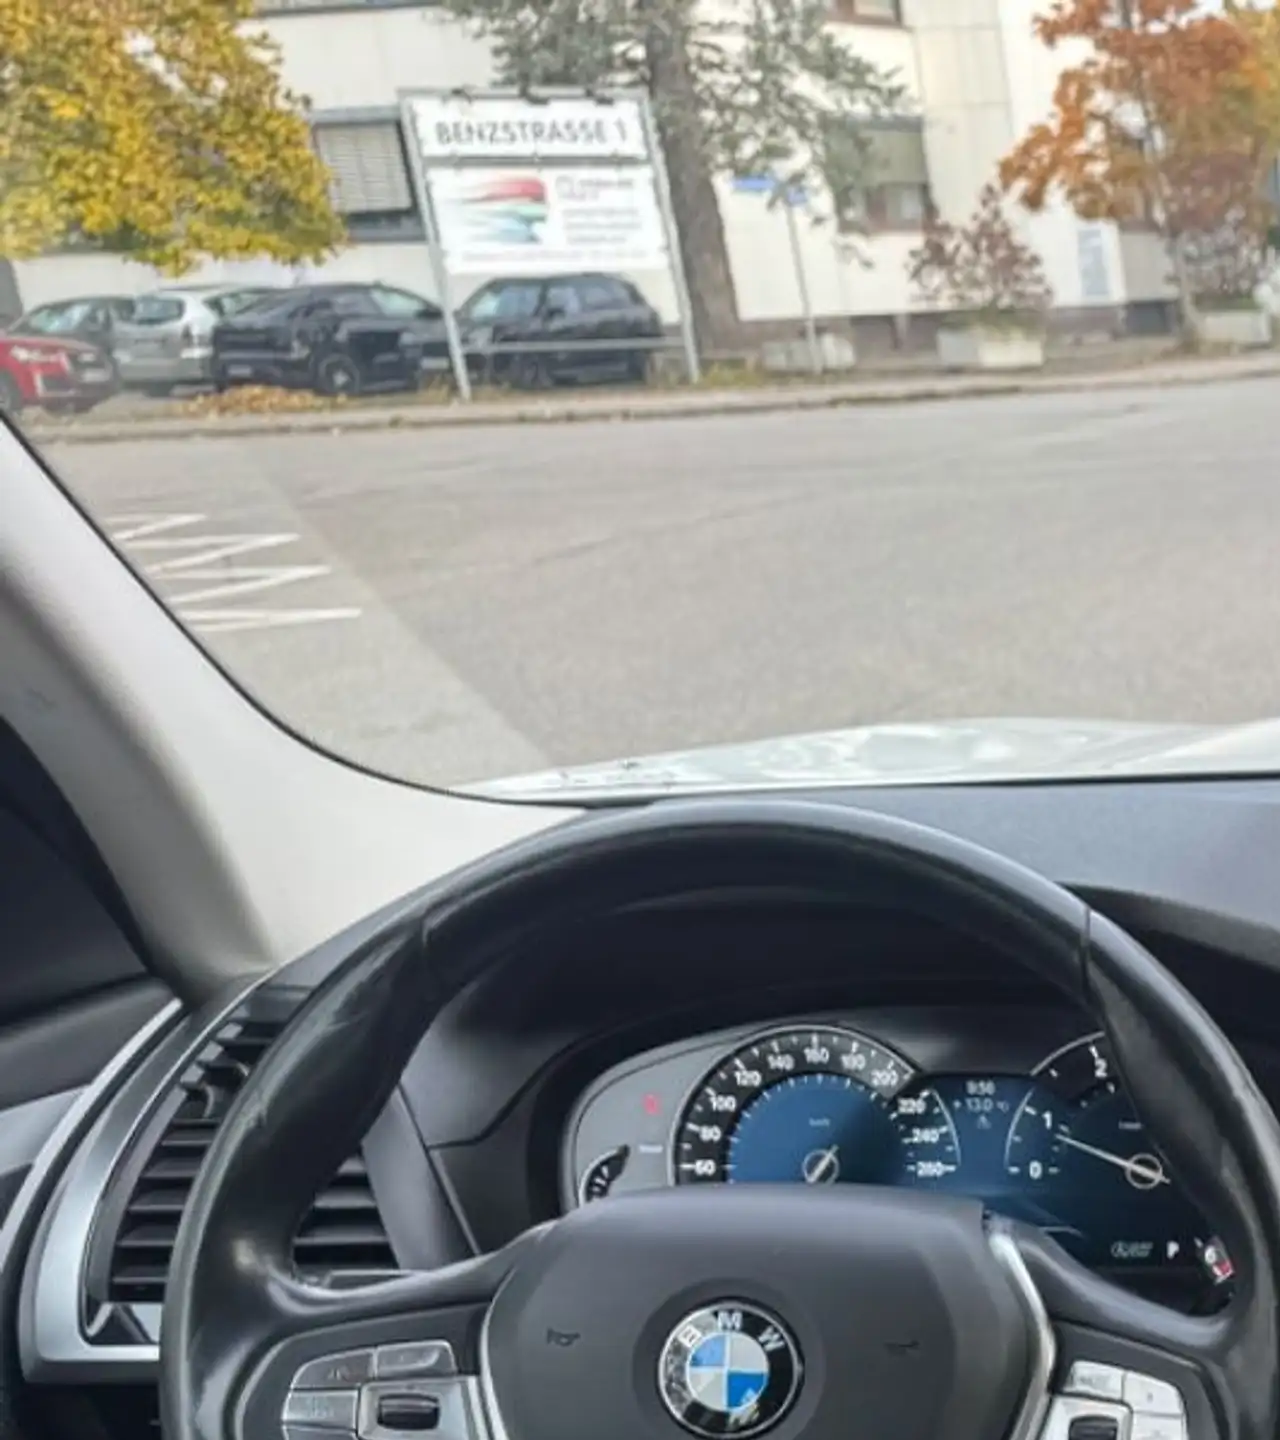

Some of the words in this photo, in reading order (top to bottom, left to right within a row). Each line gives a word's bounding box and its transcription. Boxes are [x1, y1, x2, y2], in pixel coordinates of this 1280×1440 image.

[435, 118, 607, 145] BENZSTRASSE
[767, 1053, 795, 1070] 140
[734, 1070, 762, 1087] 120
[871, 1069, 898, 1086] 200
[709, 1095, 737, 1111] 100
[1042, 1110, 1053, 1130] 1
[700, 1125, 721, 1142] 80
[694, 1159, 716, 1175] 60
[1028, 1161, 1042, 1180] 0
[677, 1310, 786, 1352] BMW
